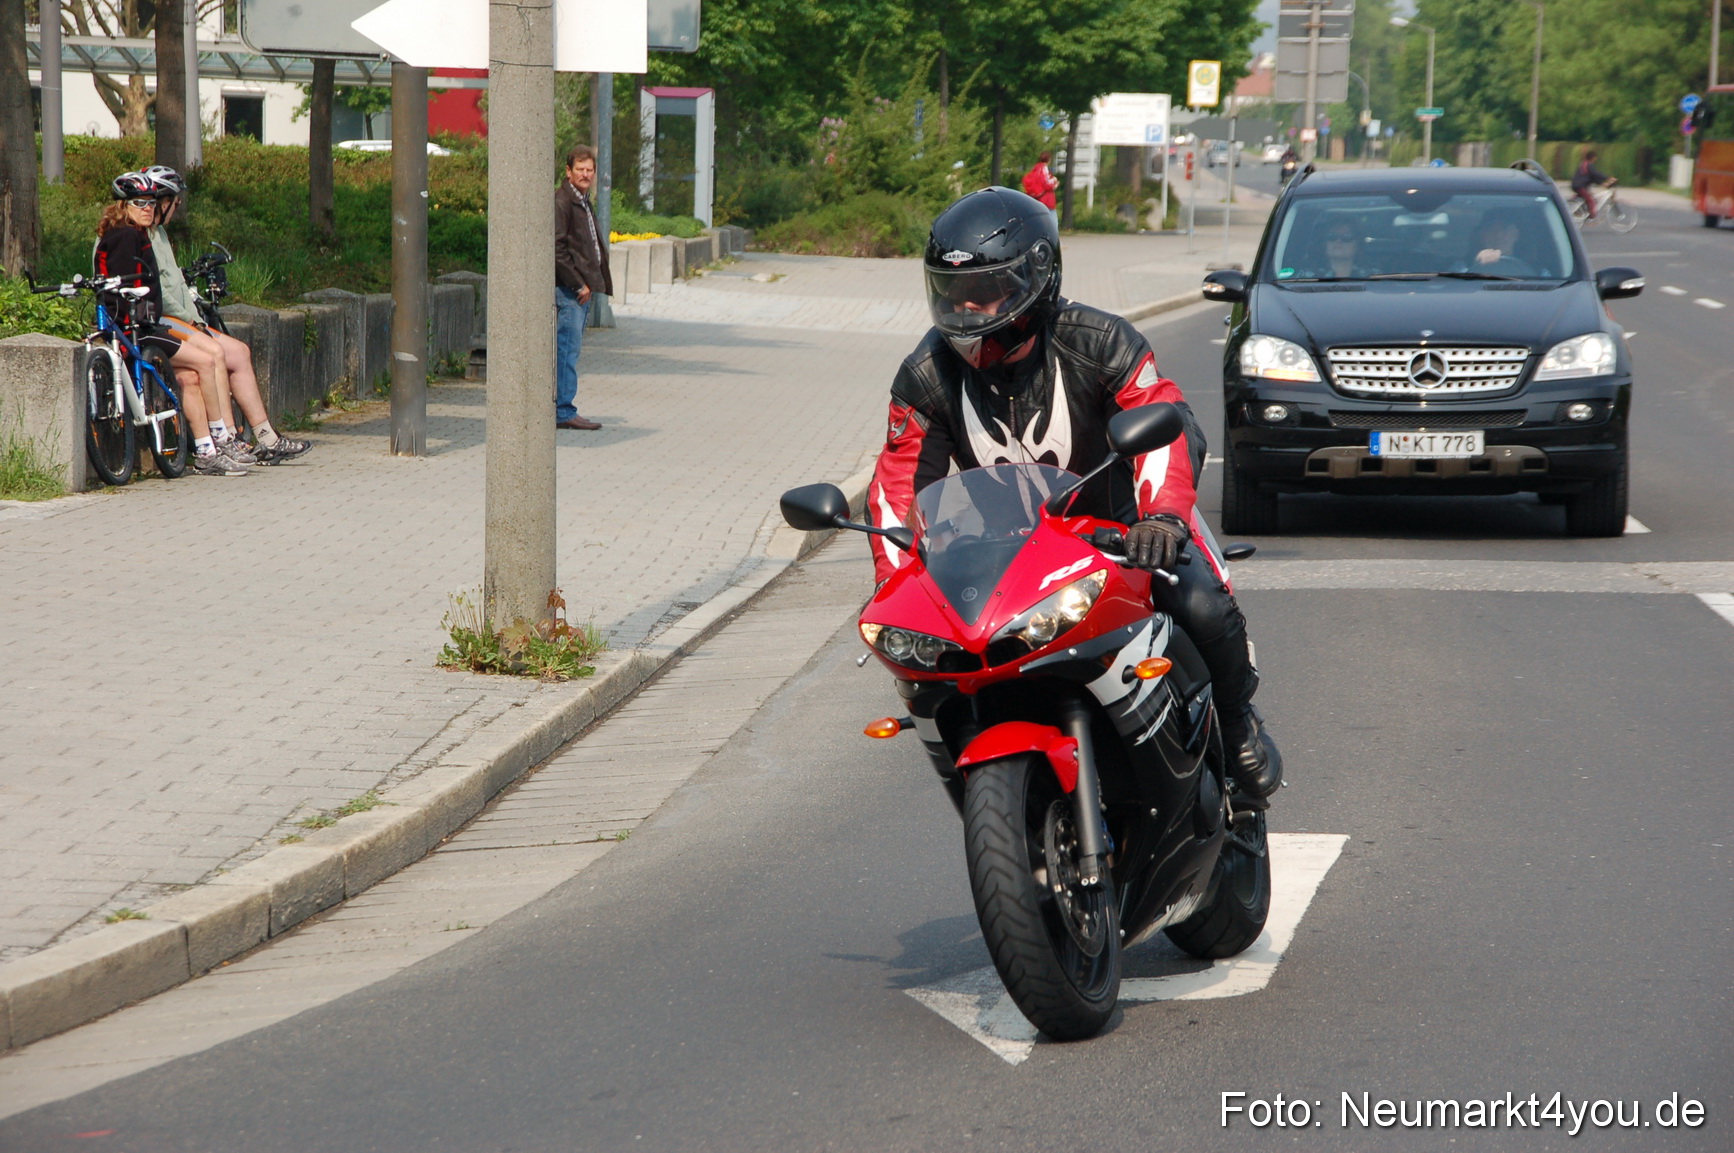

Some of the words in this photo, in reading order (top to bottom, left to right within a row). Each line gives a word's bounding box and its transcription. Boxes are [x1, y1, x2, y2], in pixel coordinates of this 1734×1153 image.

[1149, 126, 1161, 140] P
[1413, 435, 1436, 452] KT
[1442, 435, 1475, 452] 778
[1038, 554, 1095, 591] R6
